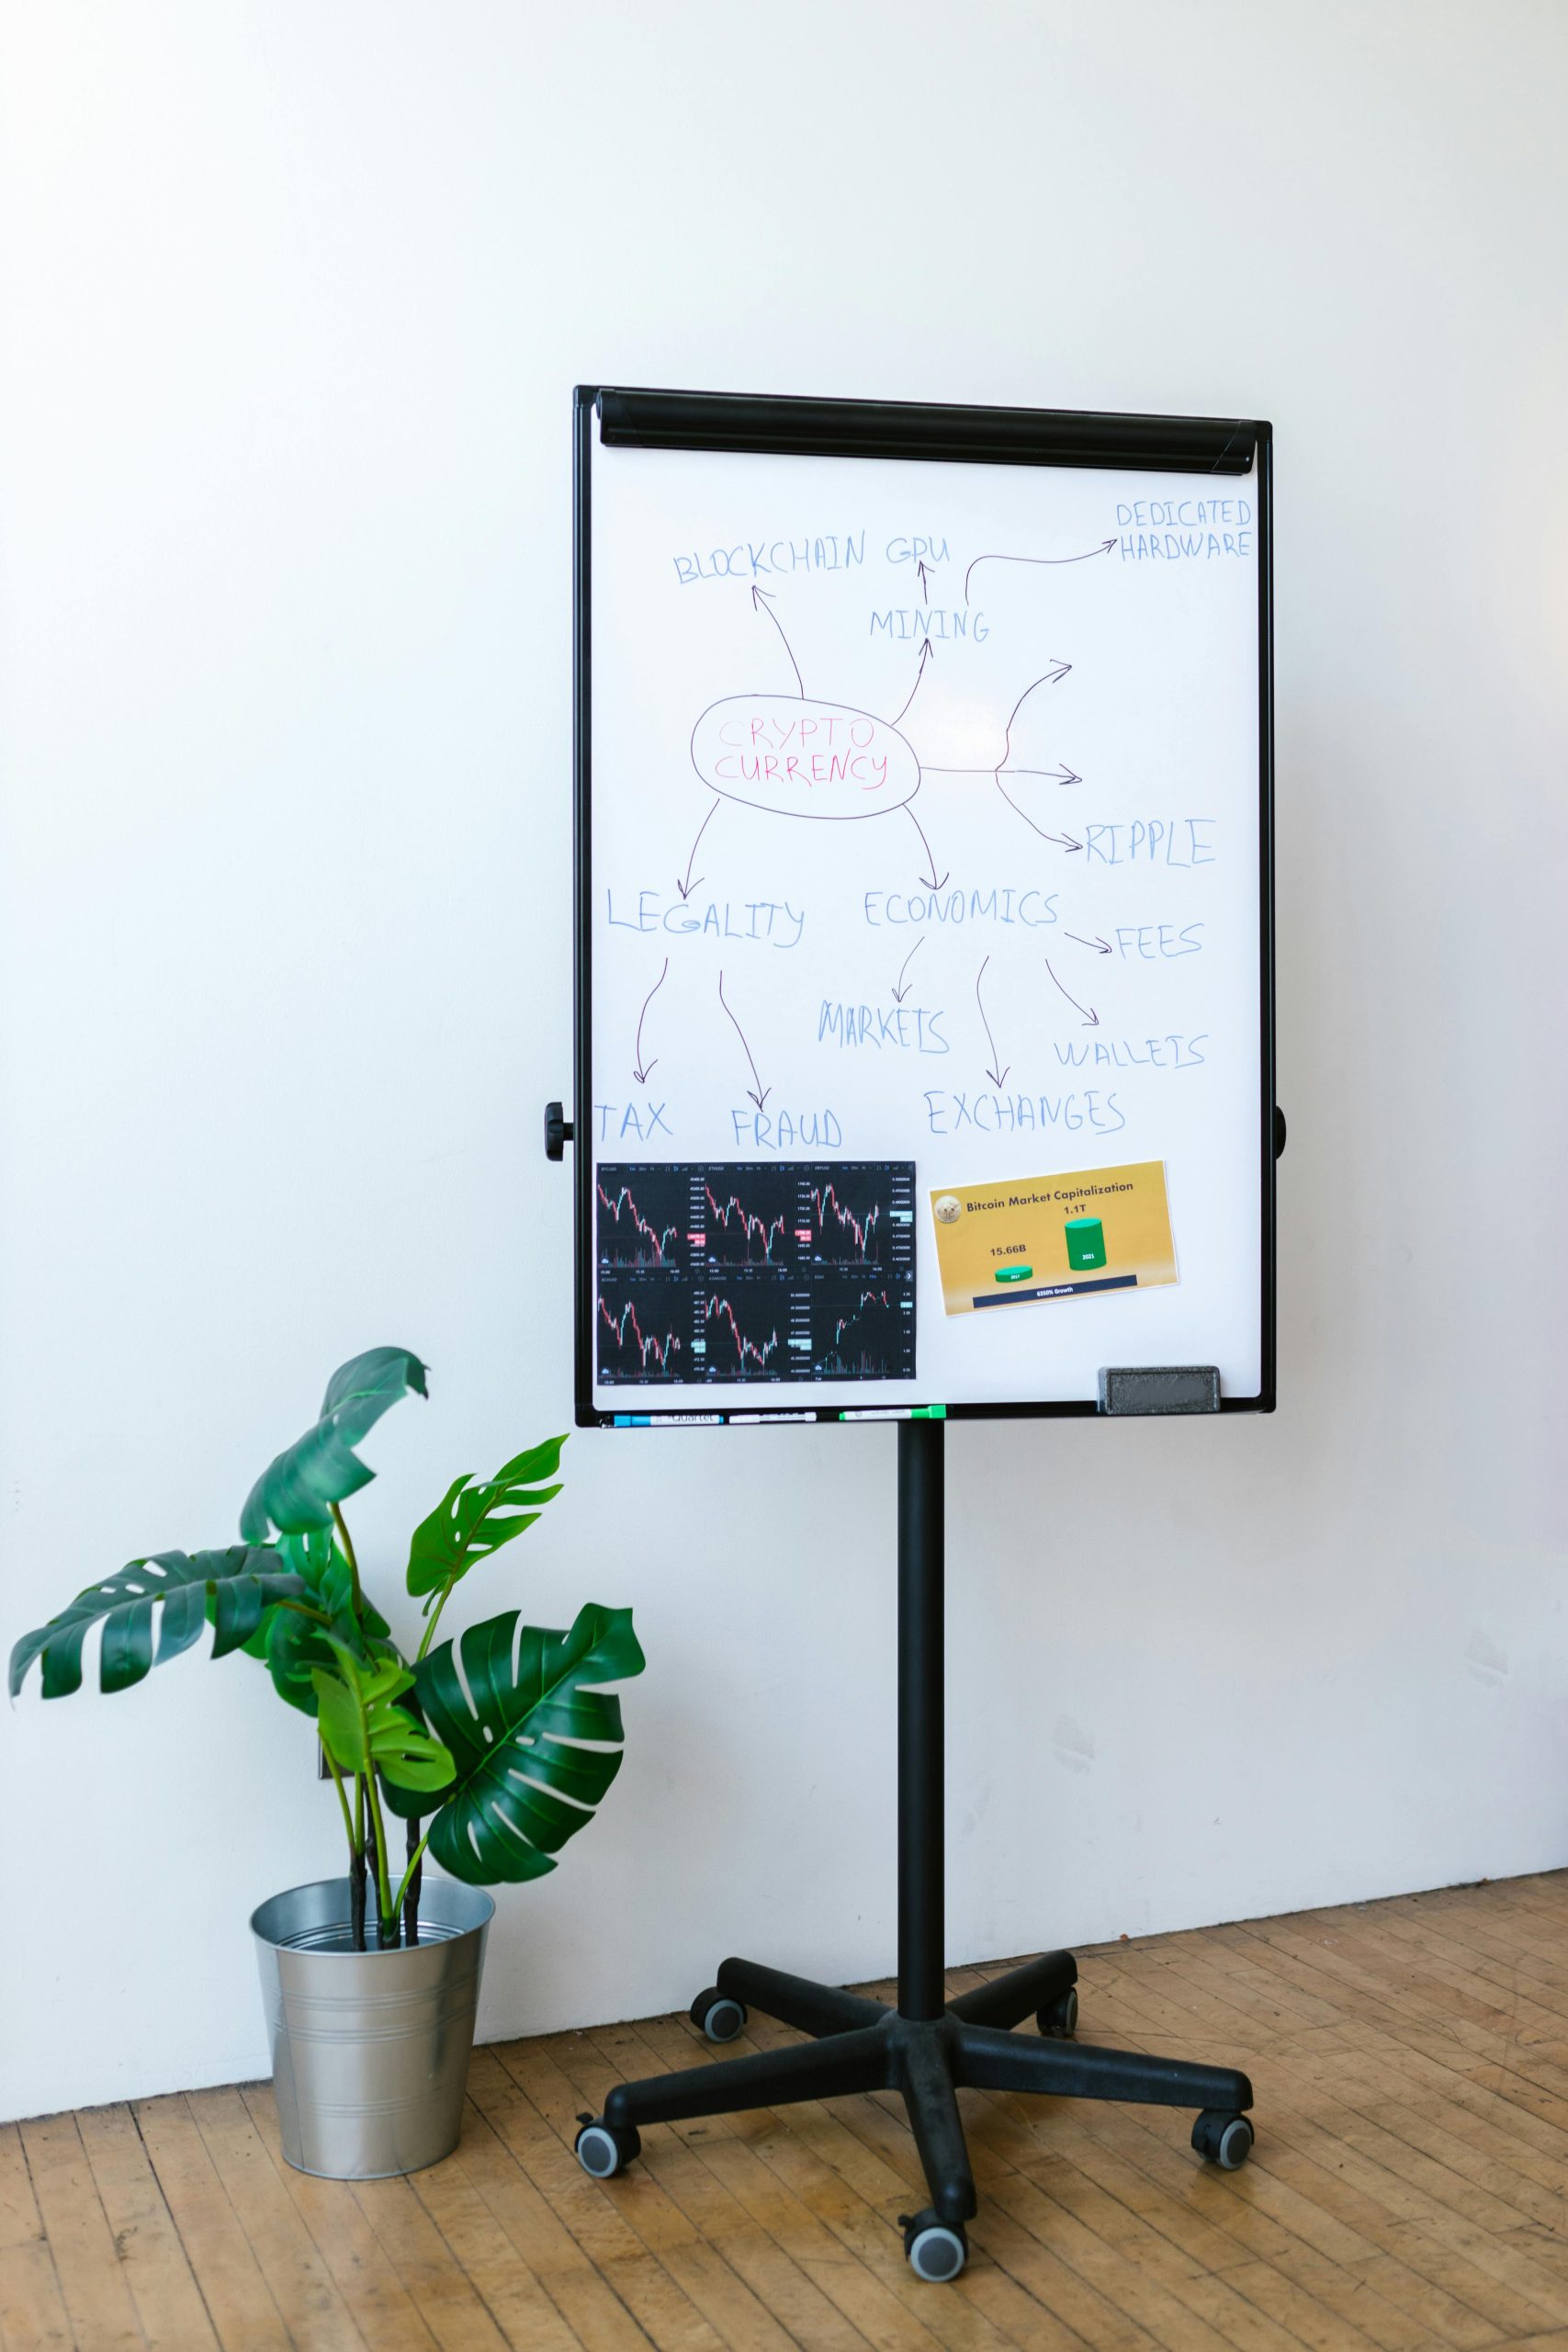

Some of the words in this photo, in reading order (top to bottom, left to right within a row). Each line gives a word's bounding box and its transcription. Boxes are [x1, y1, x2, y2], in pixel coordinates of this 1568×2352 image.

[1116, 500, 1251, 526] DEDICATED
[673, 529, 865, 584] BLOCKCHAIN
[886, 537, 950, 563] GPU
[1121, 531, 1252, 562] HARDWARE
[871, 609, 989, 642] MINING
[719, 718, 874, 750] CRYPTO
[715, 748, 887, 790] CURRENCY
[1085, 819, 1217, 868] RIPPLE
[607, 888, 805, 948] LEGALITY
[864, 889, 1059, 926] ECONOMICS
[1114, 923, 1205, 959] FEES
[818, 1000, 950, 1054] MARKETS
[1054, 1035, 1210, 1069] WALLETS
[594, 1102, 673, 1142] TAX
[731, 1109, 842, 1150] FRAUD
[923, 1091, 1126, 1136] EXCHANGES
[966, 1199, 1005, 1213] Bitcoin
[1009, 1193, 1051, 1206] Market
[1054, 1182, 1134, 1201] Capitalization
[1064, 1204, 1087, 1215] 1.1T
[990, 1244, 1026, 1257] 15.66B
[1054, 1286, 1074, 1295] Growth
